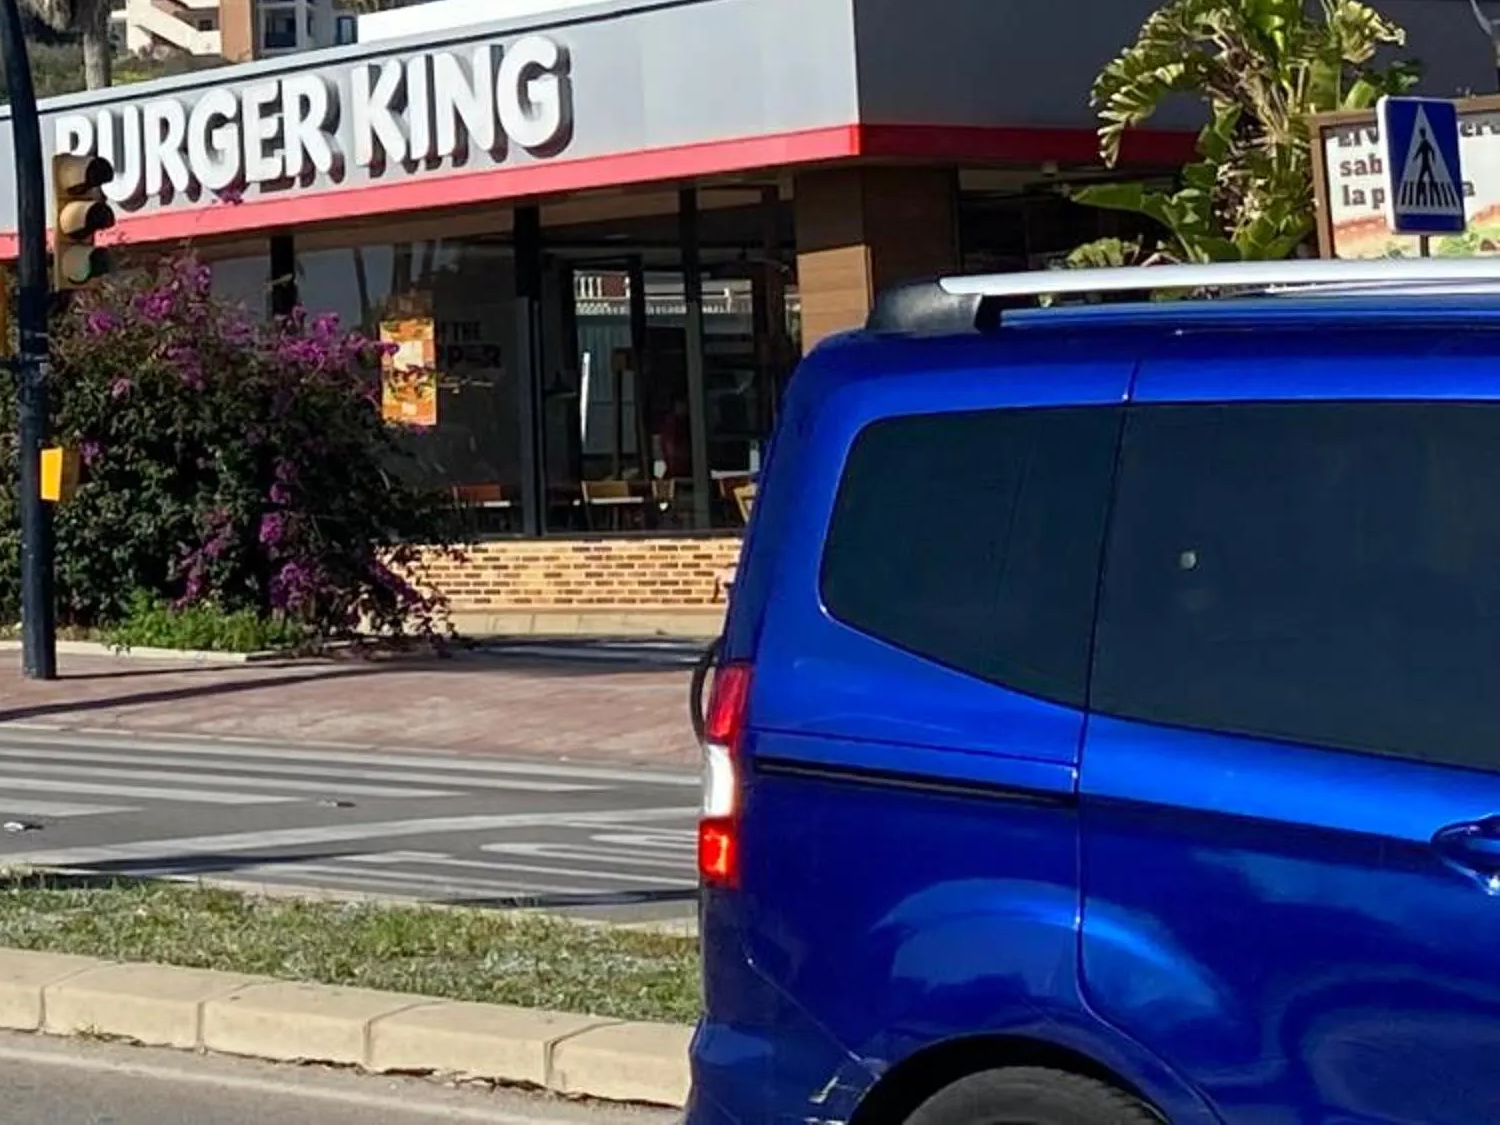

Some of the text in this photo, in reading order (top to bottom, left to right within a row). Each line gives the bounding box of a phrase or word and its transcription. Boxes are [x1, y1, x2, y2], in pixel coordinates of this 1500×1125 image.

[351, 36, 560, 166] KING
[1340, 153, 1382, 177] sab
[1342, 184, 1367, 206] la
